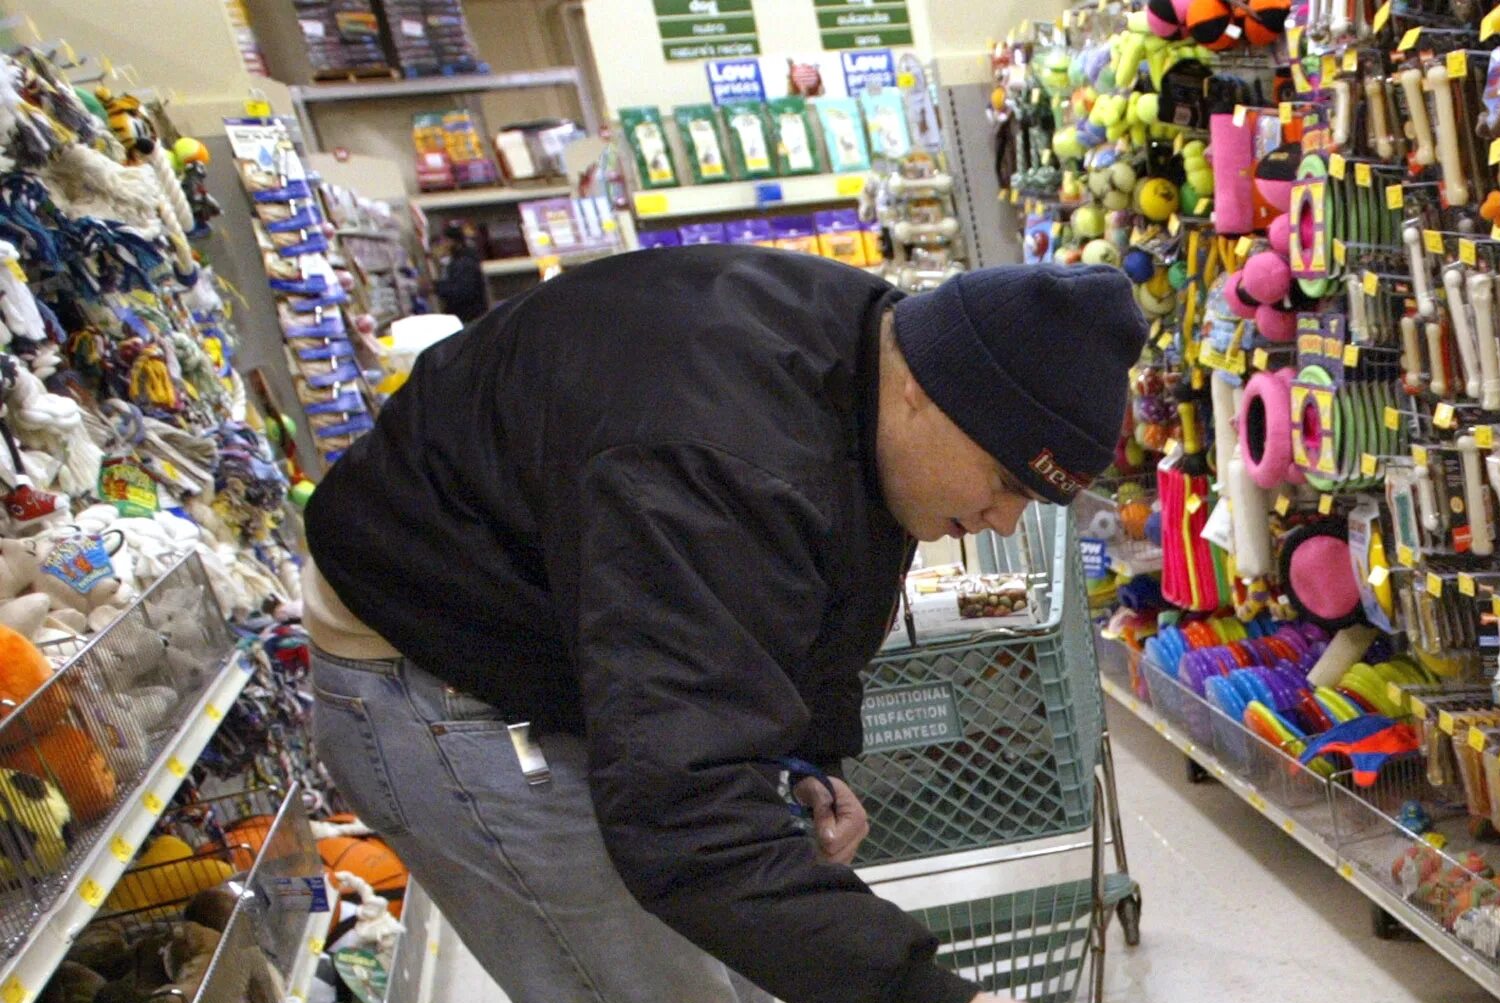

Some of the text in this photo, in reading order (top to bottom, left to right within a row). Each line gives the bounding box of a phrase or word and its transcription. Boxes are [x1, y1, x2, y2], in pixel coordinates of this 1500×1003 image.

[708, 60, 756, 82] Low
[842, 52, 889, 71] Low
[864, 722, 948, 746] UARANTEED
